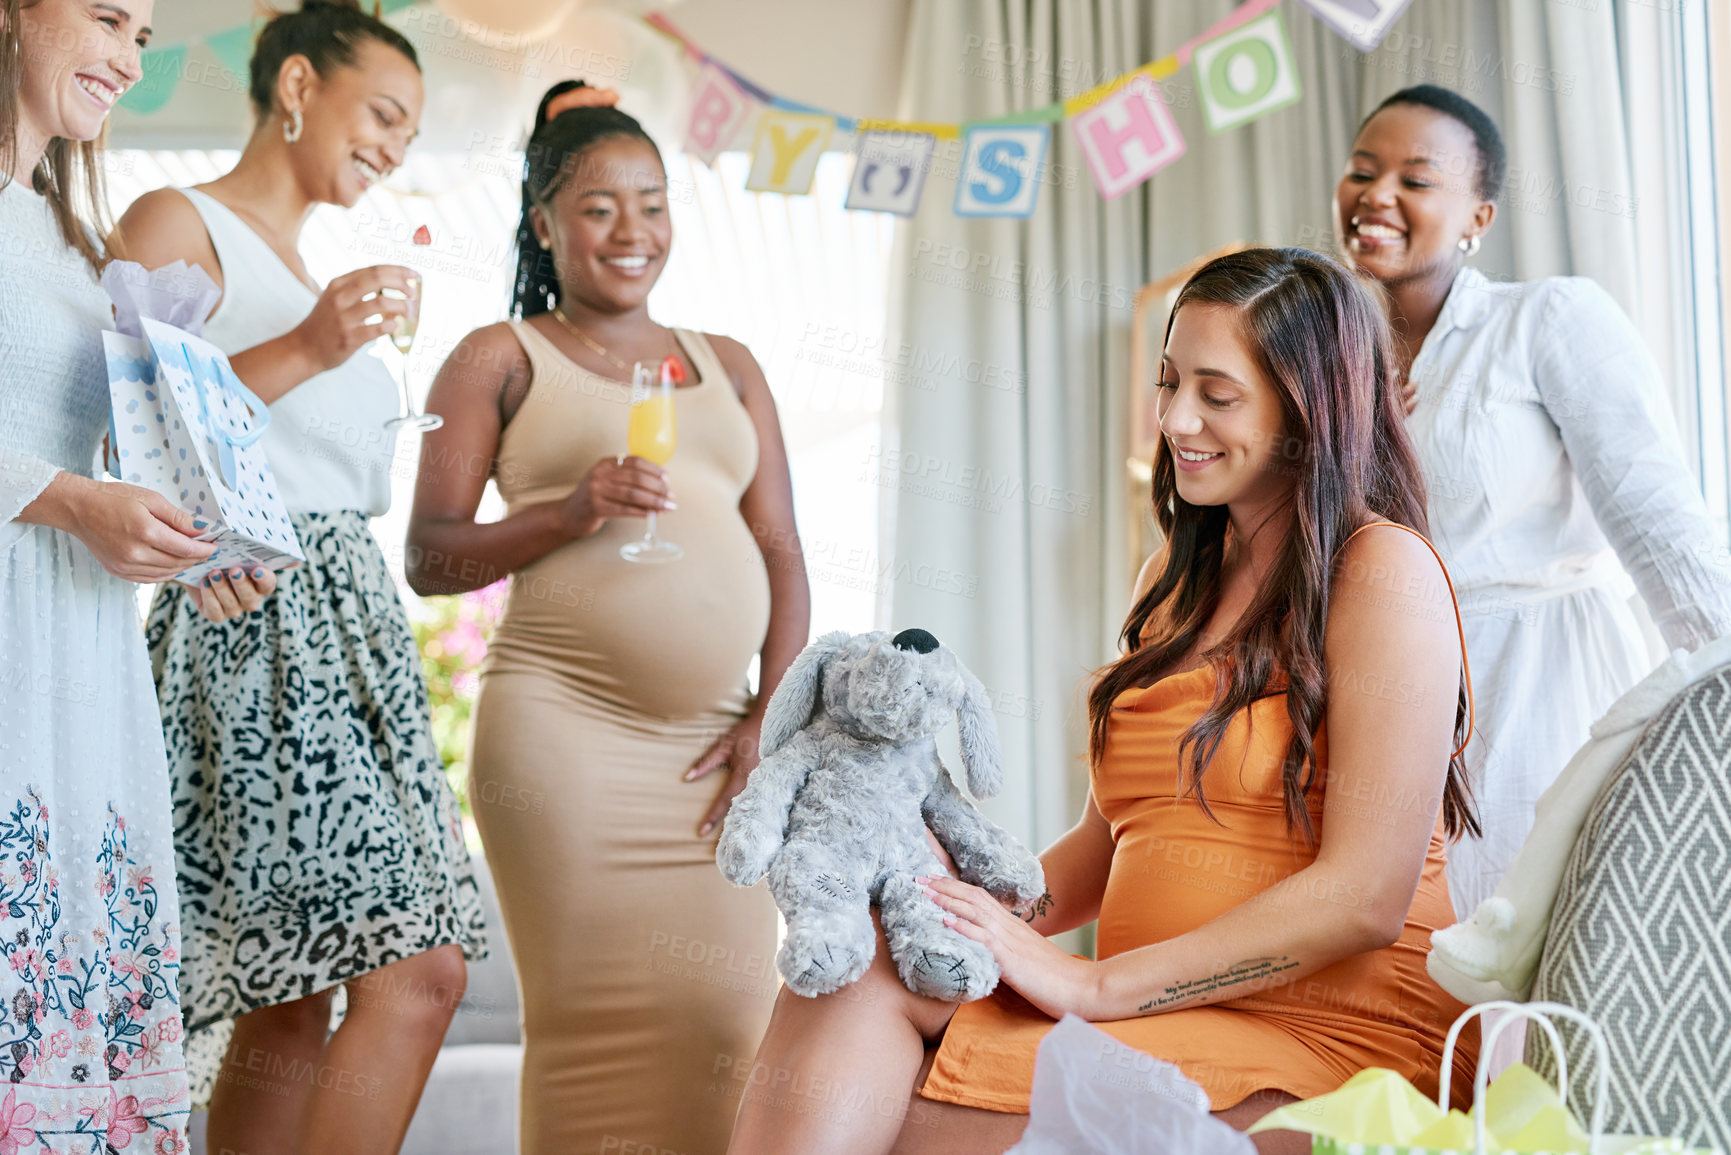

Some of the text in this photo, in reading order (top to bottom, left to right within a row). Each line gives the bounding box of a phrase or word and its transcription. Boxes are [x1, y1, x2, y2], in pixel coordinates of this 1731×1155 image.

[1139, 1001, 1152, 1011] and
[1159, 994, 1174, 1004] have
[1261, 969, 1271, 978] for
[1272, 965, 1282, 973] the
[1165, 986, 1177, 994] My
[1213, 973, 1229, 983] from
